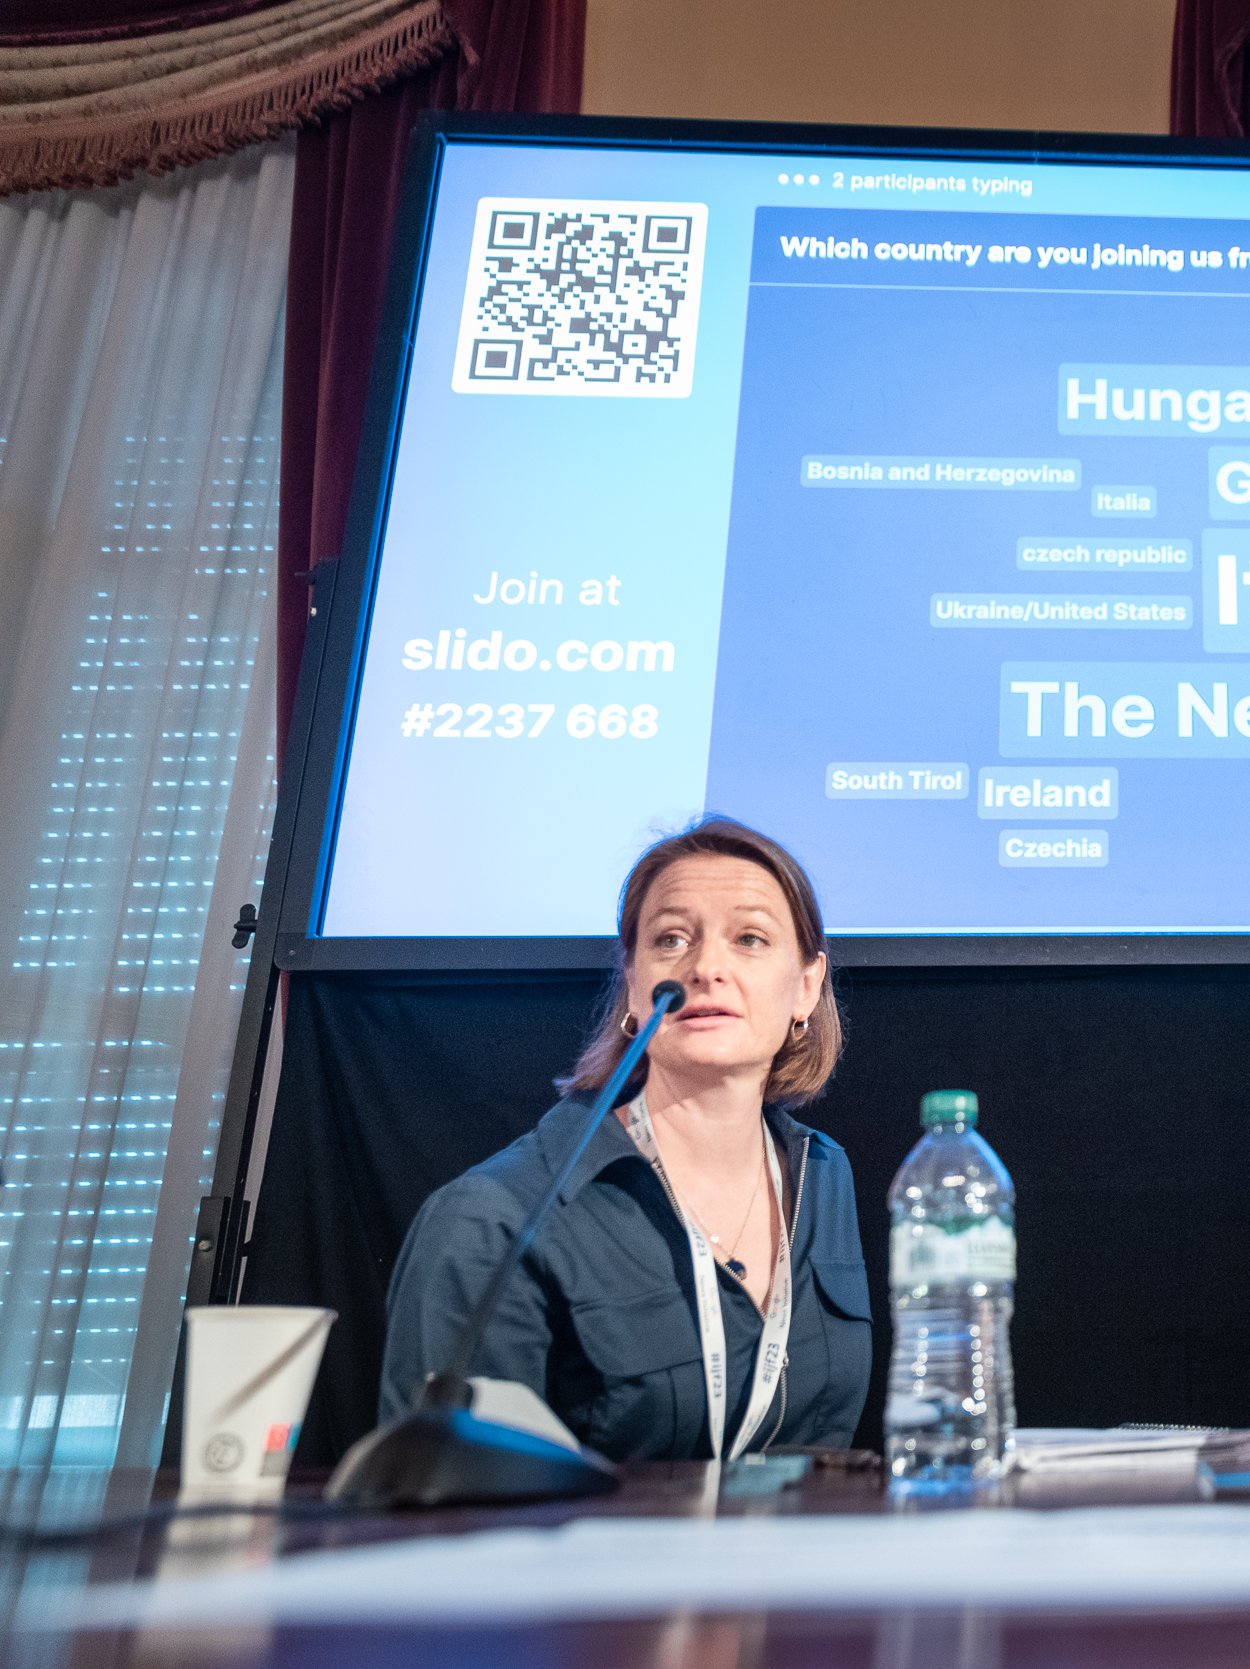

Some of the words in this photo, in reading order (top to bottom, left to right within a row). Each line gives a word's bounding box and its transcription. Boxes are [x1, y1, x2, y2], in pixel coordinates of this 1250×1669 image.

[833, 172, 844, 188] 2
[851, 174, 965, 193] participants
[972, 177, 1032, 196] typing
[780, 236, 868, 259] Which
[874, 242, 982, 266] country
[988, 246, 1031, 263] are
[1037, 247, 1087, 267] you
[1091, 243, 1184, 271] joining
[1191, 251, 1223, 268] us
[808, 462, 883, 480] Bosnia
[888, 464, 930, 480] and
[936, 464, 1075, 485] Herzegovina
[1098, 493, 1150, 510] Italia
[1023, 545, 1089, 562] czech
[1096, 545, 1186, 566] republic
[474, 571, 563, 605] Join
[579, 575, 621, 606] at
[937, 601, 1108, 621] Ukraine/United
[1114, 603, 1185, 620] States
[402, 628, 675, 672] slido.com
[401, 703, 555, 738] #2237
[567, 704, 658, 739] 668
[1011, 682, 1154, 737] The
[832, 771, 901, 789] South
[907, 771, 961, 789] Tirol
[985, 779, 1110, 807] Ireland
[1006, 838, 1101, 857] Czechia
[711, 1353, 722, 1398] #ijf23
[763, 1342, 780, 1384] #ijf23
